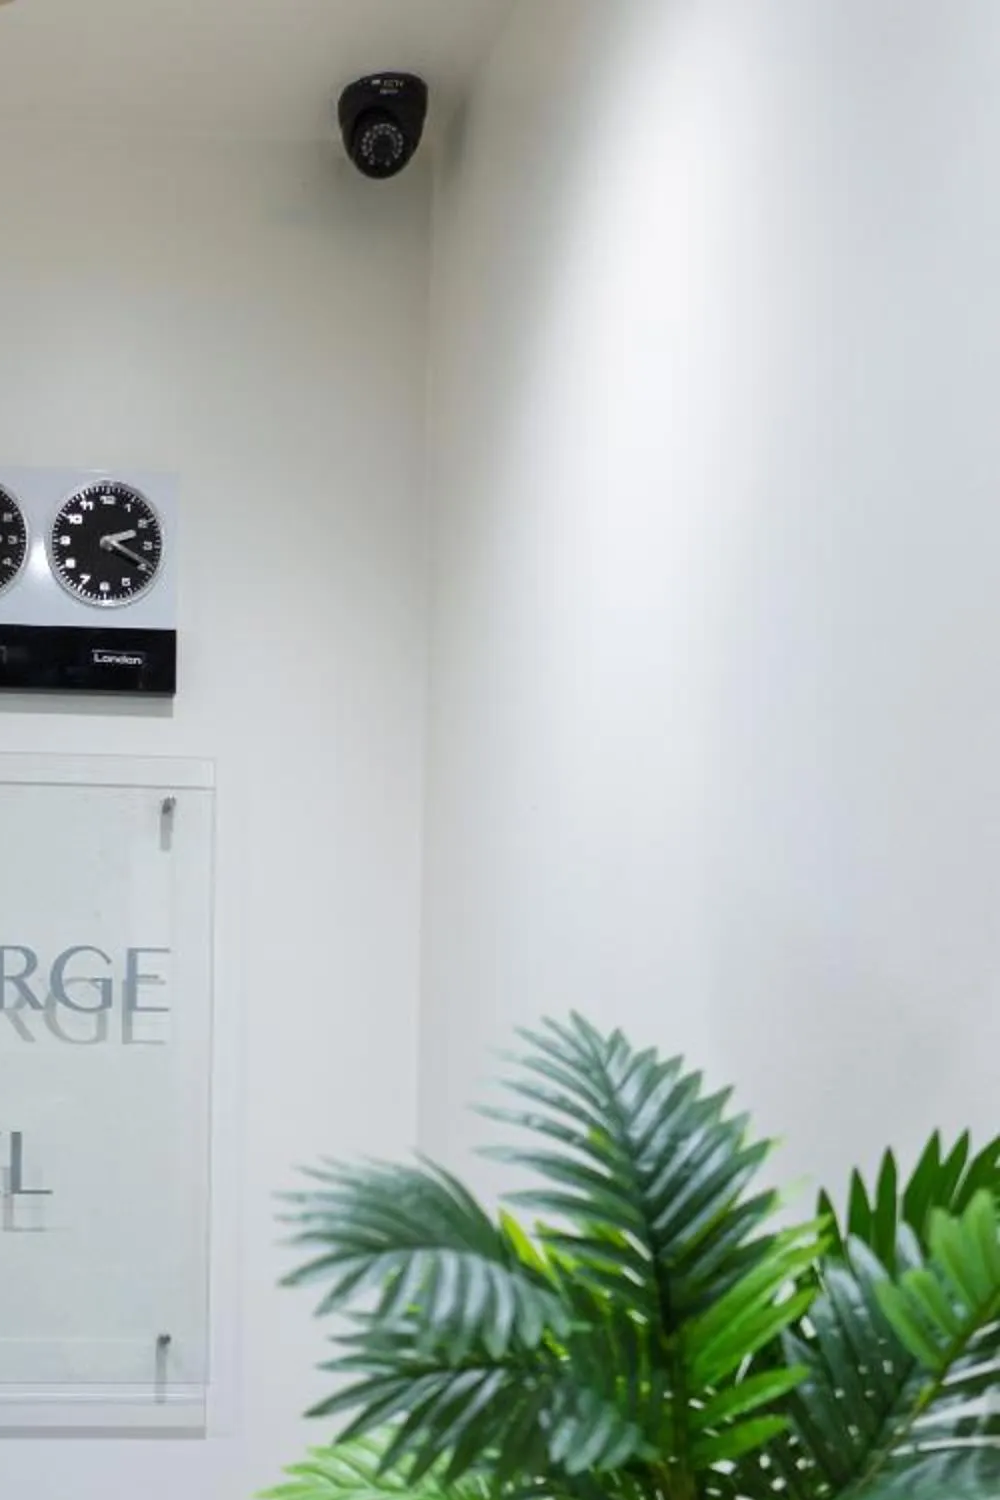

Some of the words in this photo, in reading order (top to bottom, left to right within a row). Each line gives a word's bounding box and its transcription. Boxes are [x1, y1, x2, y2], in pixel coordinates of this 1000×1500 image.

[80, 501, 93, 511] 11
[125, 503, 132, 513] 1
[67, 514, 83, 525] 10
[80, 573, 91, 585] 7
[93, 652, 143, 665] London
